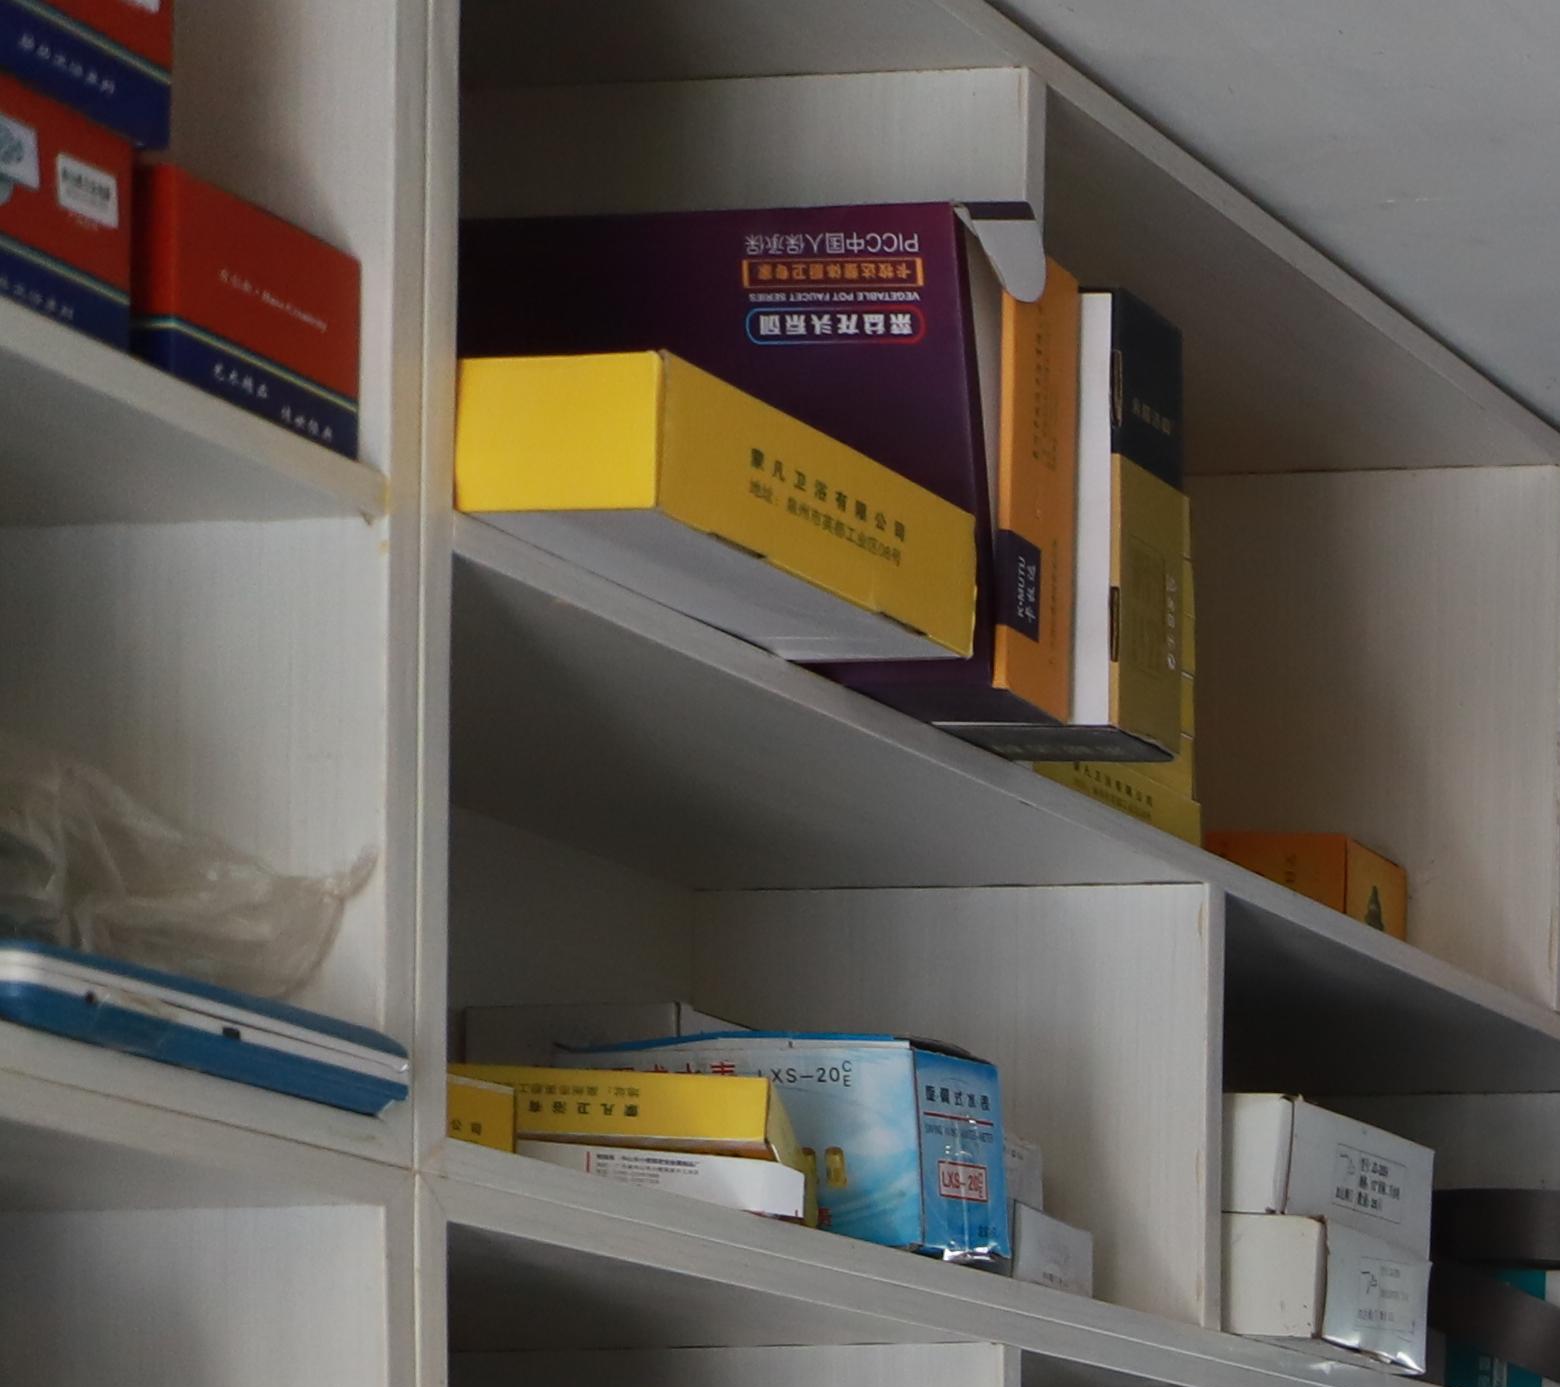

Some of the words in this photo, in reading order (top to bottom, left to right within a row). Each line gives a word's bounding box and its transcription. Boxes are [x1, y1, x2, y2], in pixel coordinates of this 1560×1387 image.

[744, 232, 920, 254] PICC中国人保承保
[749, 292, 787, 302] SERIES
[789, 292, 830, 302] FAUCET
[833, 292, 854, 302] POT
[857, 292, 920, 302] VEGETABLE
[760, 314, 912, 336] 菜盆龙头系列
